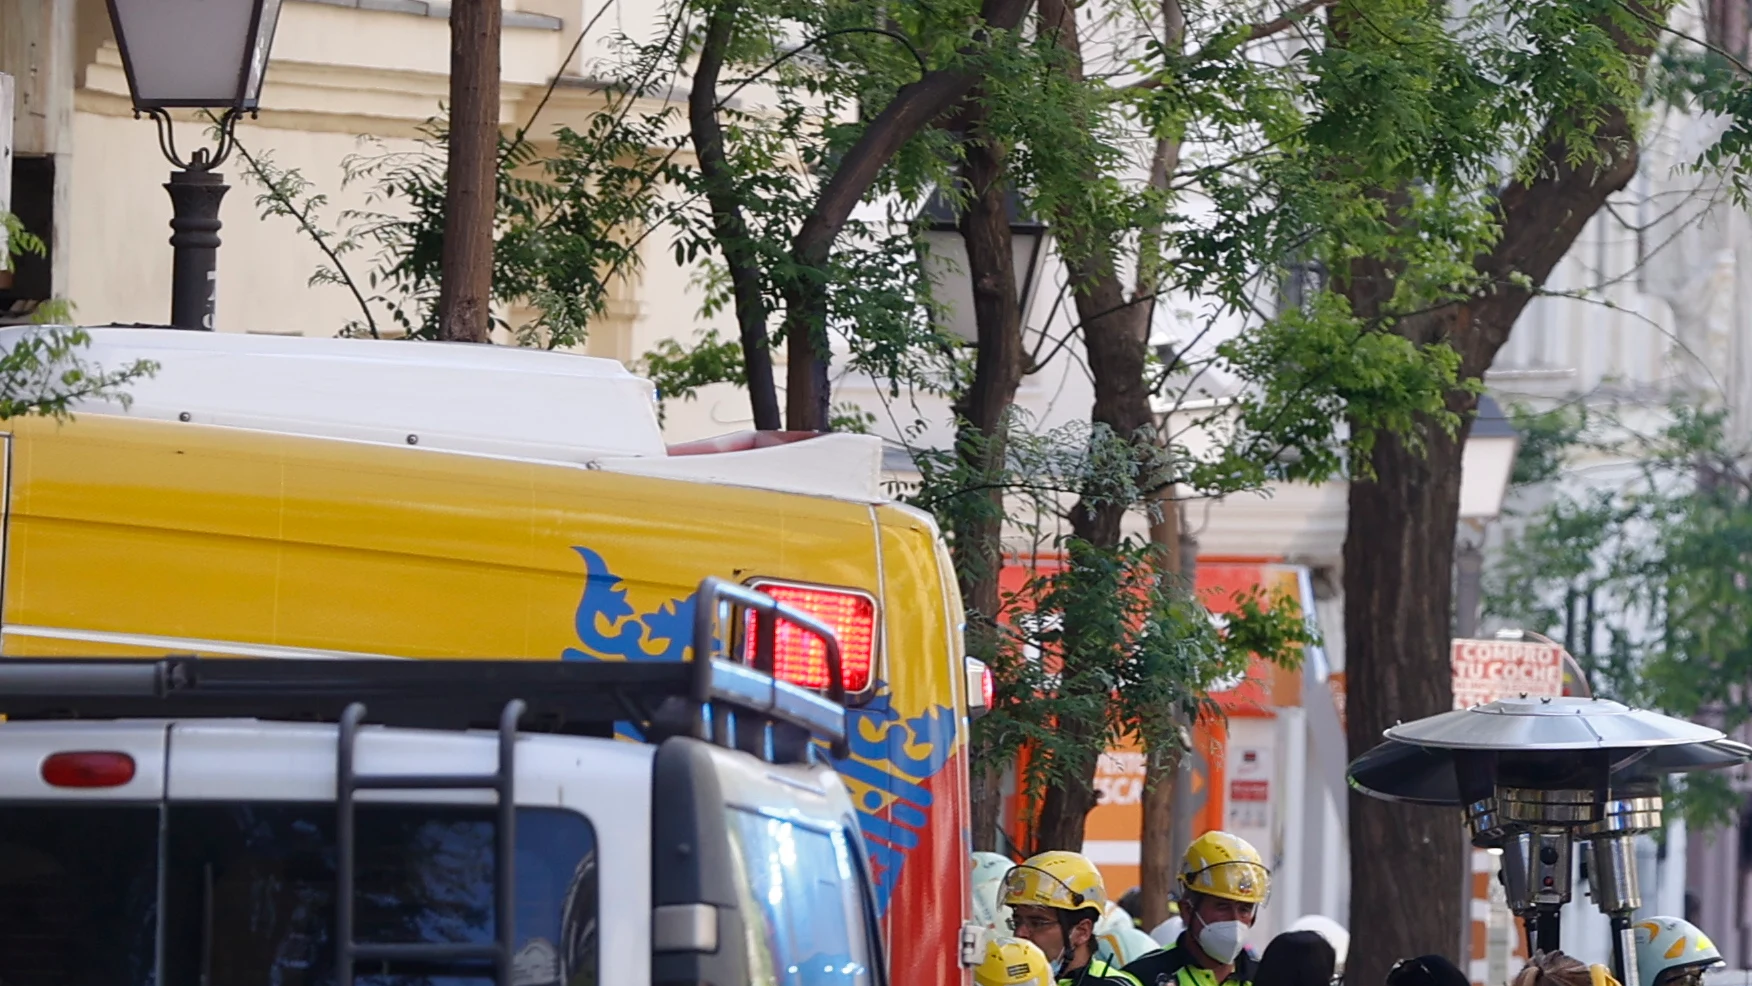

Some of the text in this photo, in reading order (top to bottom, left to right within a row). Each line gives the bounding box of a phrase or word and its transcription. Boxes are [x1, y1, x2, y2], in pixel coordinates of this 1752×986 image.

[1462, 644, 1553, 663] COMPRO
[1456, 661, 1557, 682] TU COCHE
